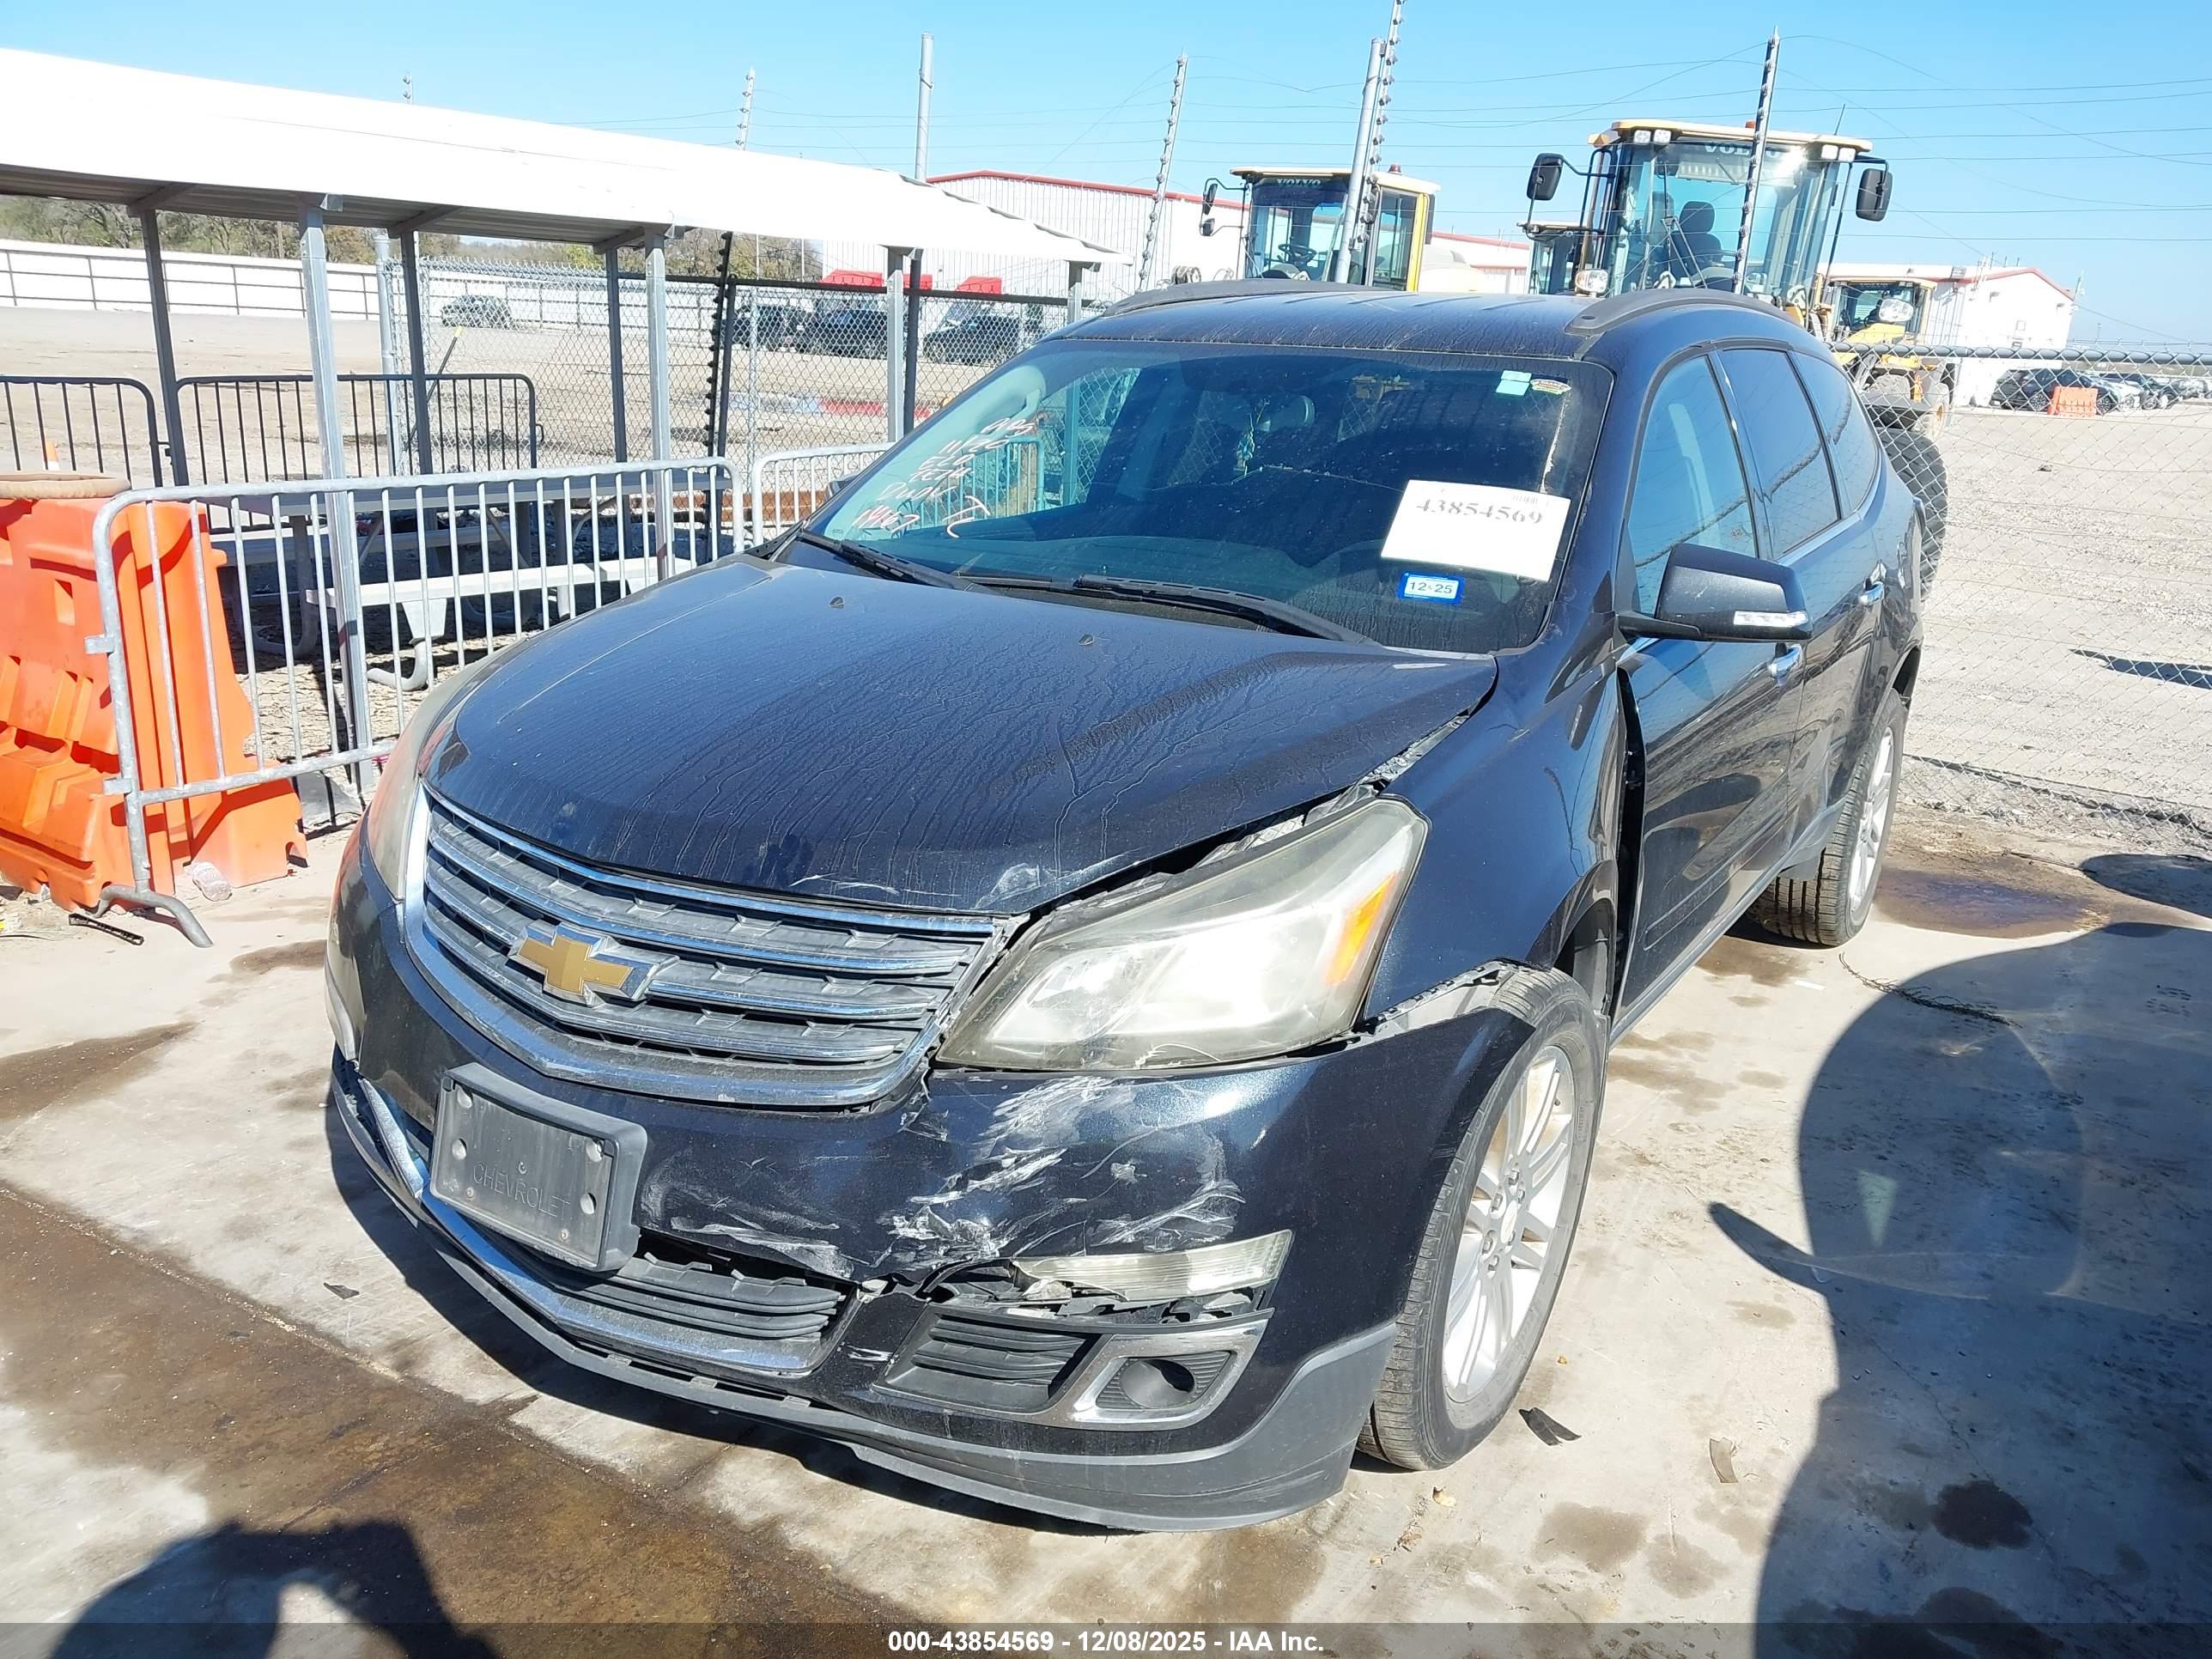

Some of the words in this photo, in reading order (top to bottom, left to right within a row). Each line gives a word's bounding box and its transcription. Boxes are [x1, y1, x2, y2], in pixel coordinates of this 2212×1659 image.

[1705, 144, 1781, 158] VOLO
[1277, 178, 1322, 188] VOLVO
[1416, 498, 1543, 524] 43854569
[473, 1162, 571, 1220] CHEVROLET
